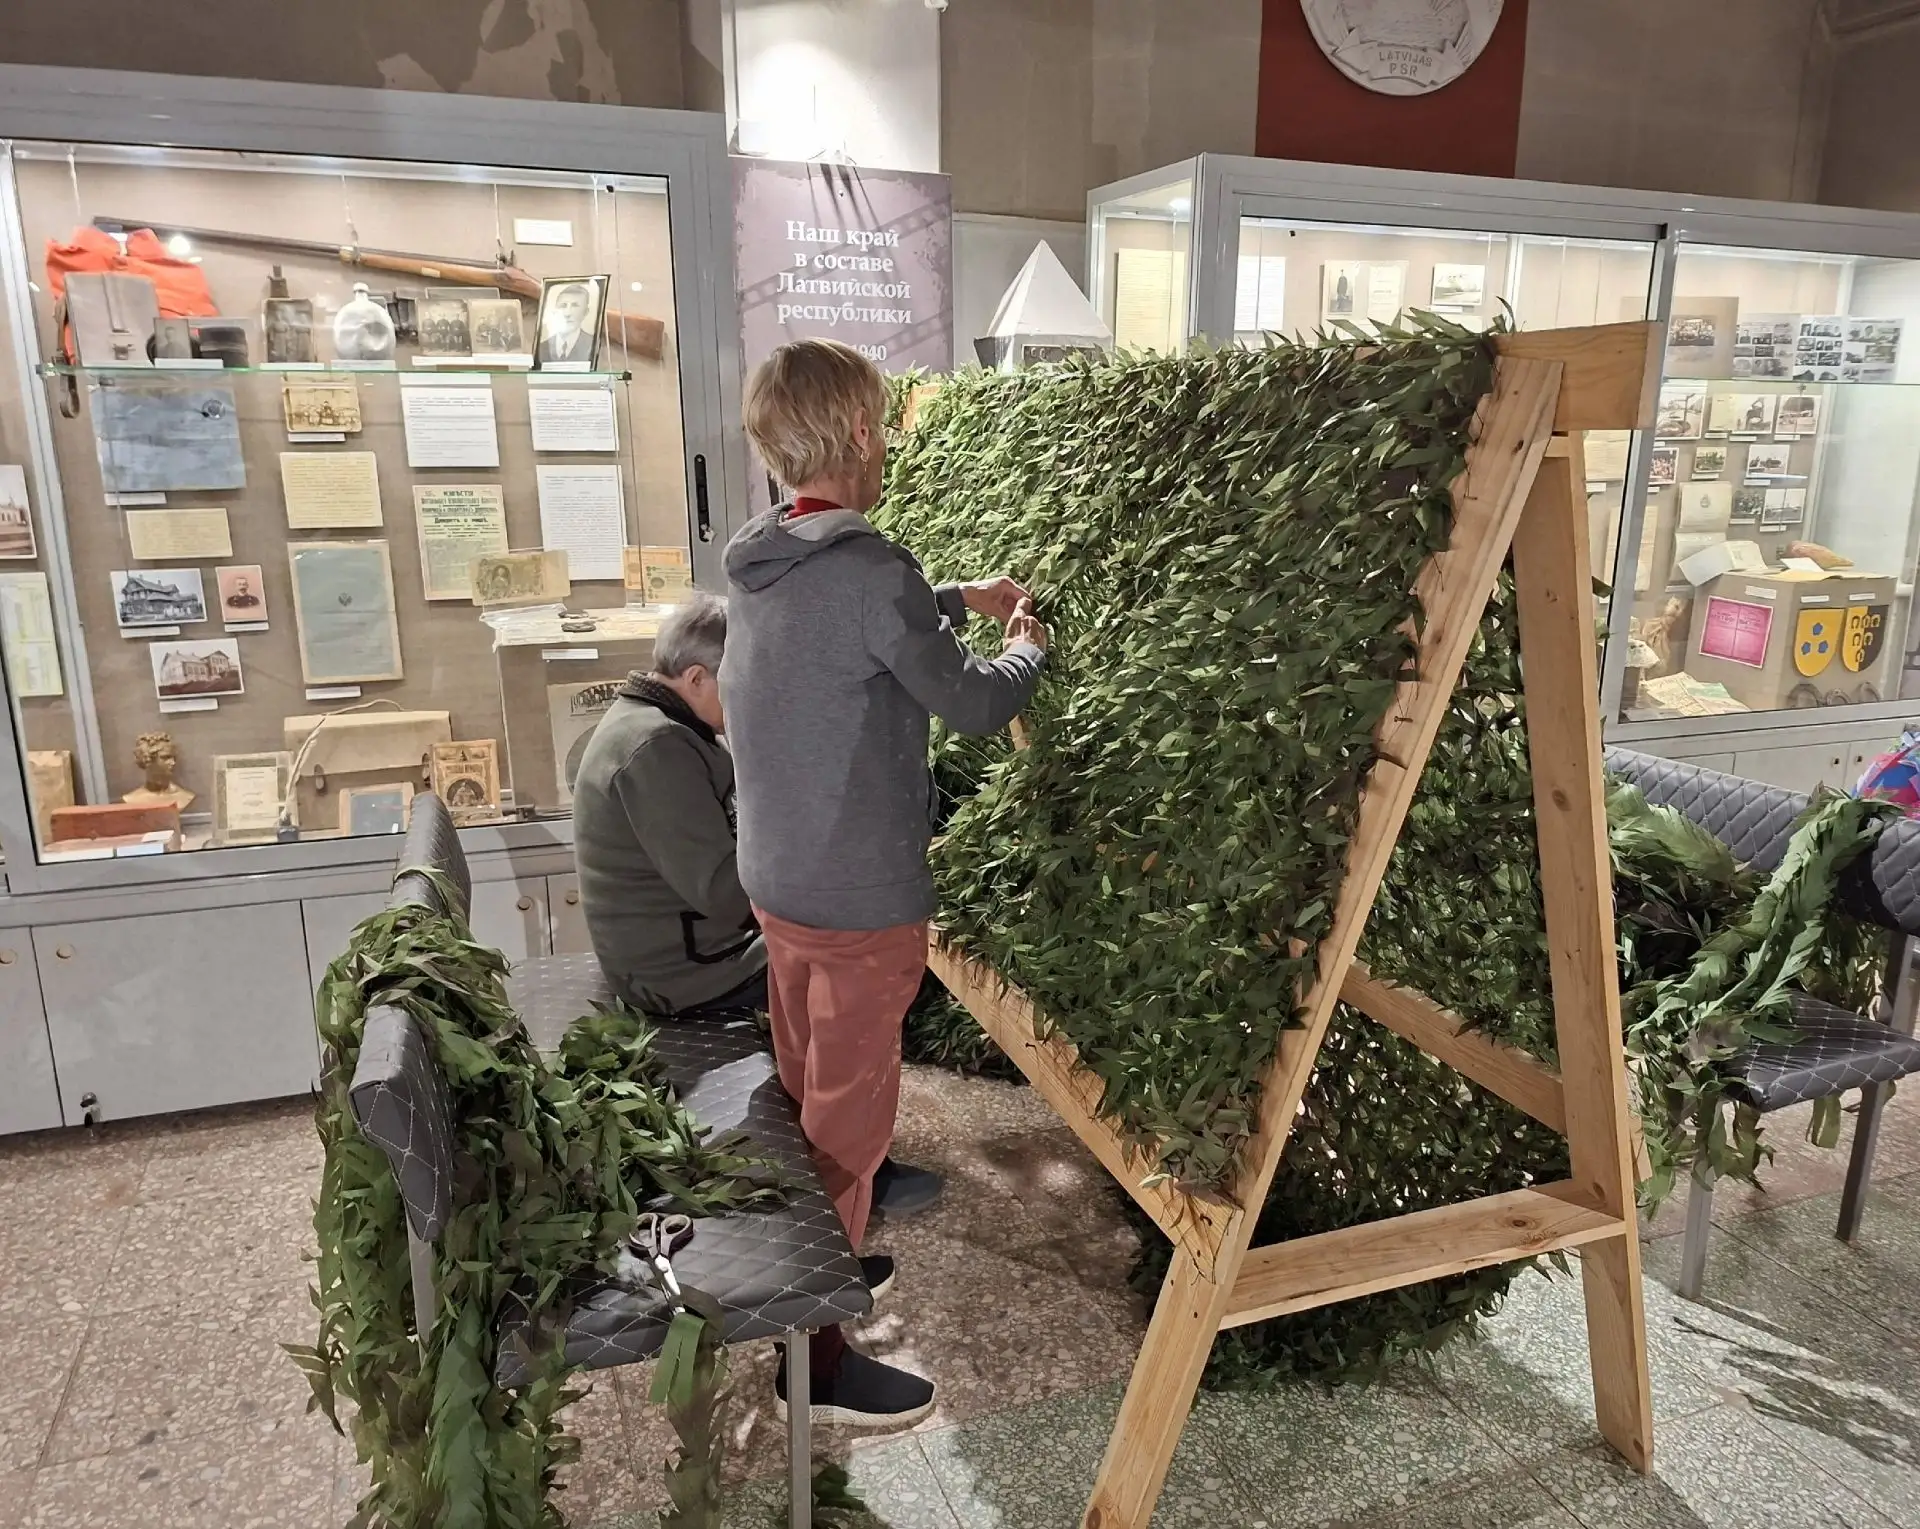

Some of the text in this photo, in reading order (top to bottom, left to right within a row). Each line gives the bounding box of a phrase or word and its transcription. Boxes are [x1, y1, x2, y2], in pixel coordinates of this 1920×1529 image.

[1379, 51, 1433, 67] LATVIJAS
[1389, 62, 1418, 77] PSR
[785, 220, 900, 252] Наш край
[793, 253, 894, 273] в составе
[776, 272, 912, 299] Латвийской
[776, 301, 912, 327] республики
